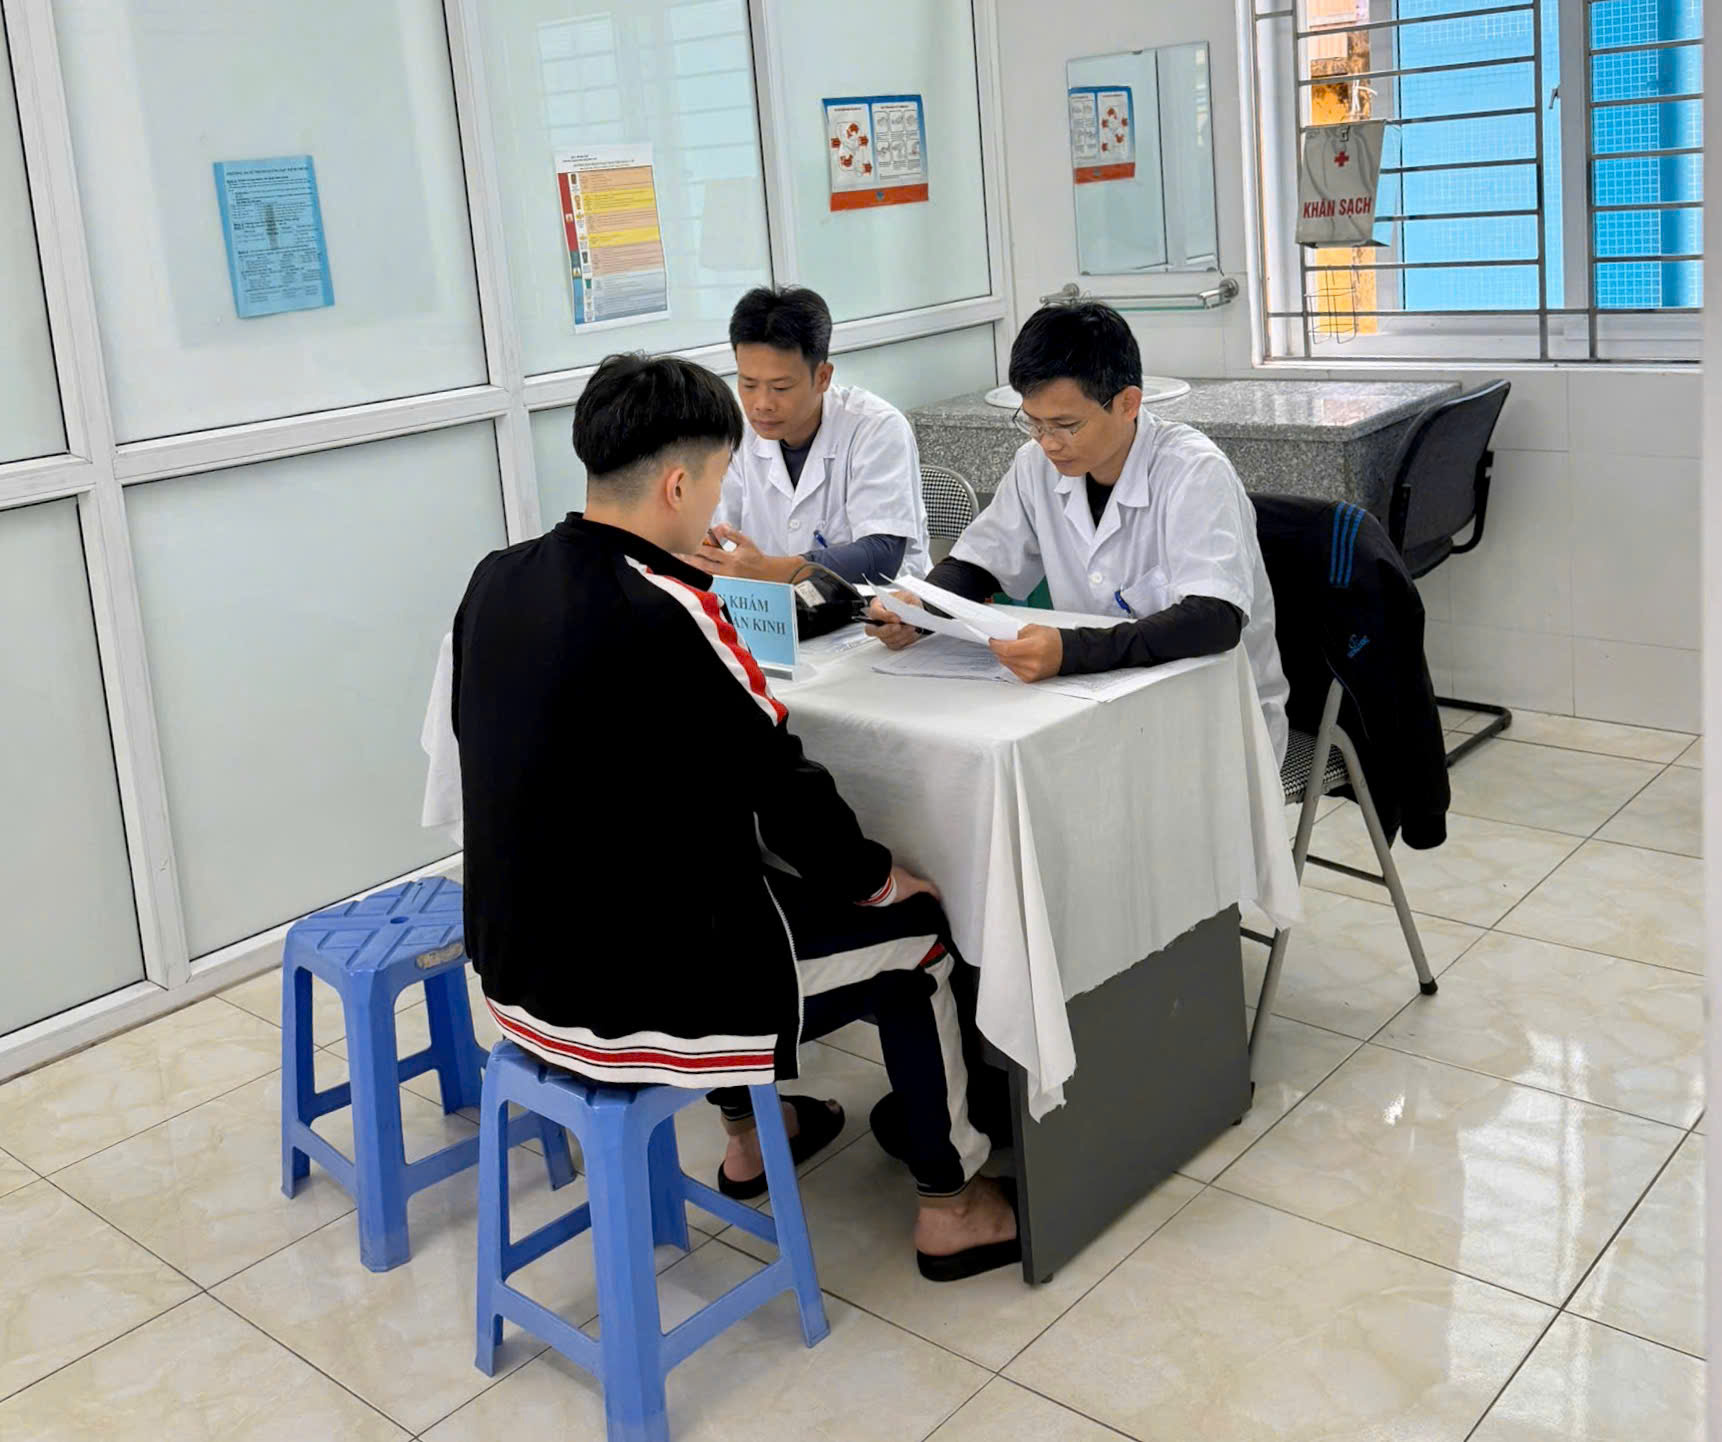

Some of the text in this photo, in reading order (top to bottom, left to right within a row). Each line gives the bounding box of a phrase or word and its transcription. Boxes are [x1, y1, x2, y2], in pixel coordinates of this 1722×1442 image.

[1339, 197, 1372, 218] SẠCH
[730, 593, 769, 613] KHÁM
[752, 617, 786, 634] KINH
